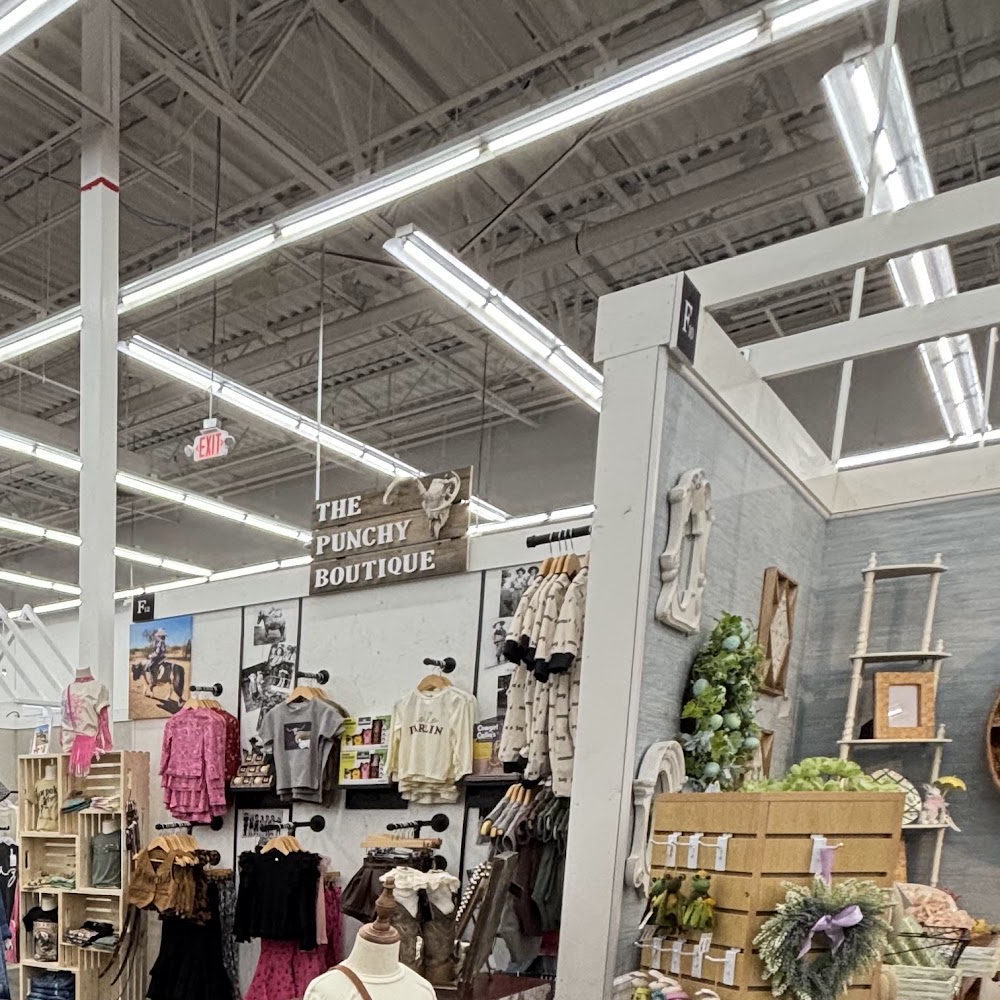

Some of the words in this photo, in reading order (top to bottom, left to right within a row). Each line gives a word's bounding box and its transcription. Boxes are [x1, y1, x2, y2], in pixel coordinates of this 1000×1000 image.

[200, 432, 222, 459] EXIT
[315, 495, 362, 523] THE
[315, 519, 413, 556] PUNCHY
[314, 549, 436, 589] BOUTIQUE
